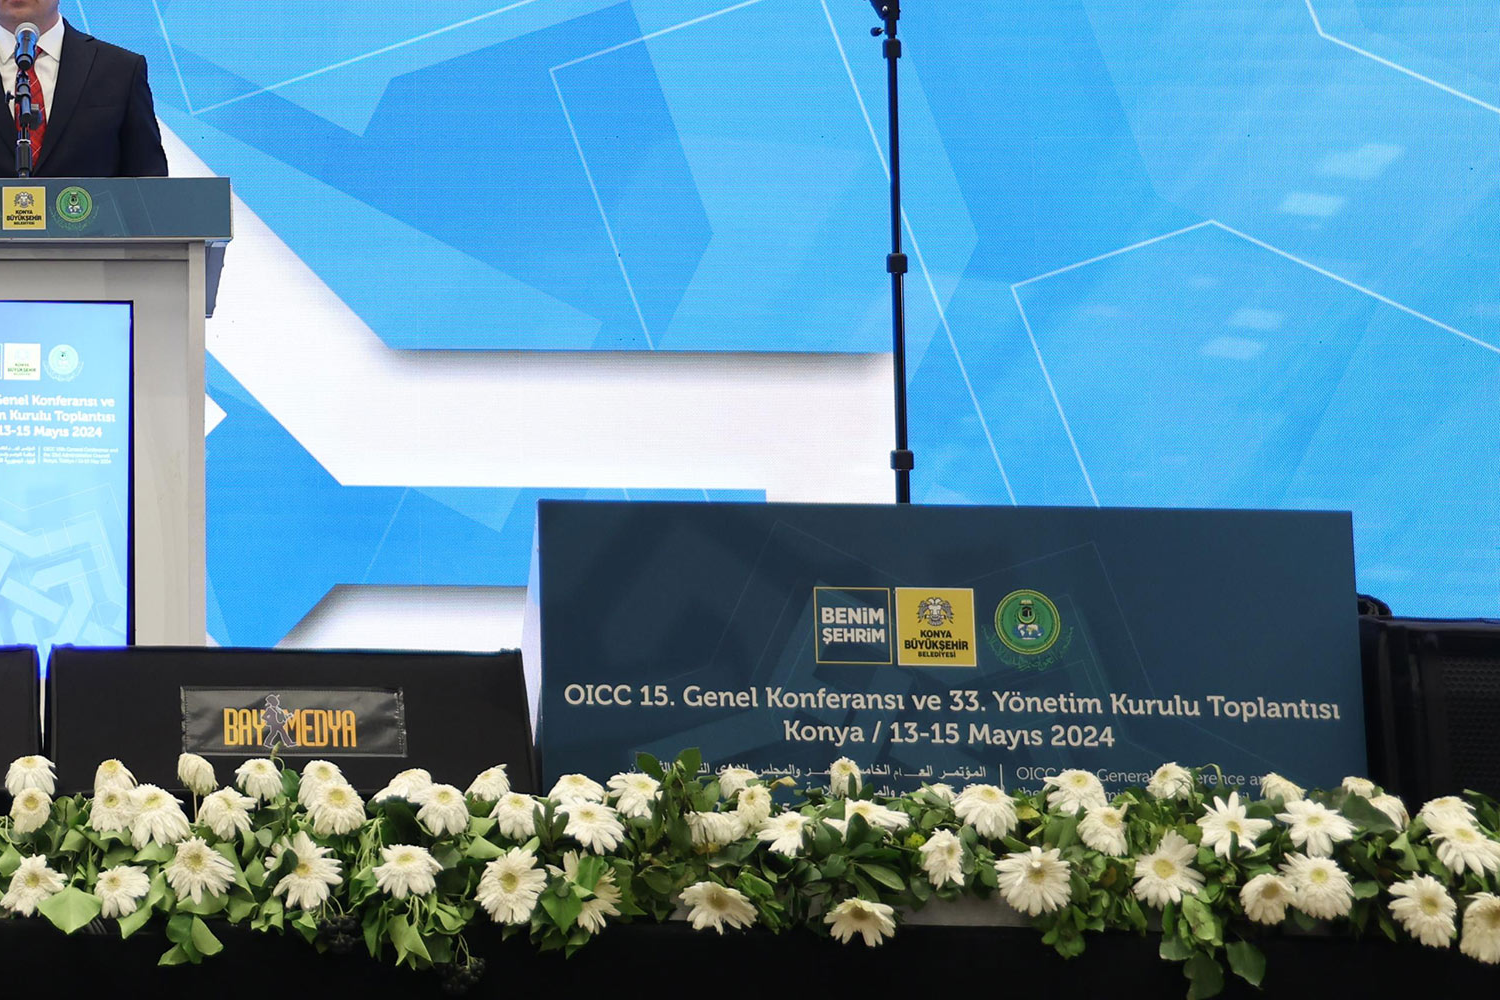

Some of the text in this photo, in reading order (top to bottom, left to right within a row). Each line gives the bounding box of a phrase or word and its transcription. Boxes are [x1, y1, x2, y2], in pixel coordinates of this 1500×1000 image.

[32, 395, 98, 407] Konferansı
[101, 398, 115, 407] ve
[10, 410, 52, 421] Kurulu
[33, 425, 69, 439] Mayıs
[72, 426, 103, 438] 2024
[920, 630, 952, 639] KONYA
[904, 638, 969, 652] BÜYÜKŞEHİR
[564, 683, 1341, 720] OICC 15. Genel Konferansı ve 33. Yönetim Kurulu Toplantısı
[223, 707, 357, 748] BAY MEDYA
[783, 719, 1116, 751] Konya / 13-15 Mayıs 2024
